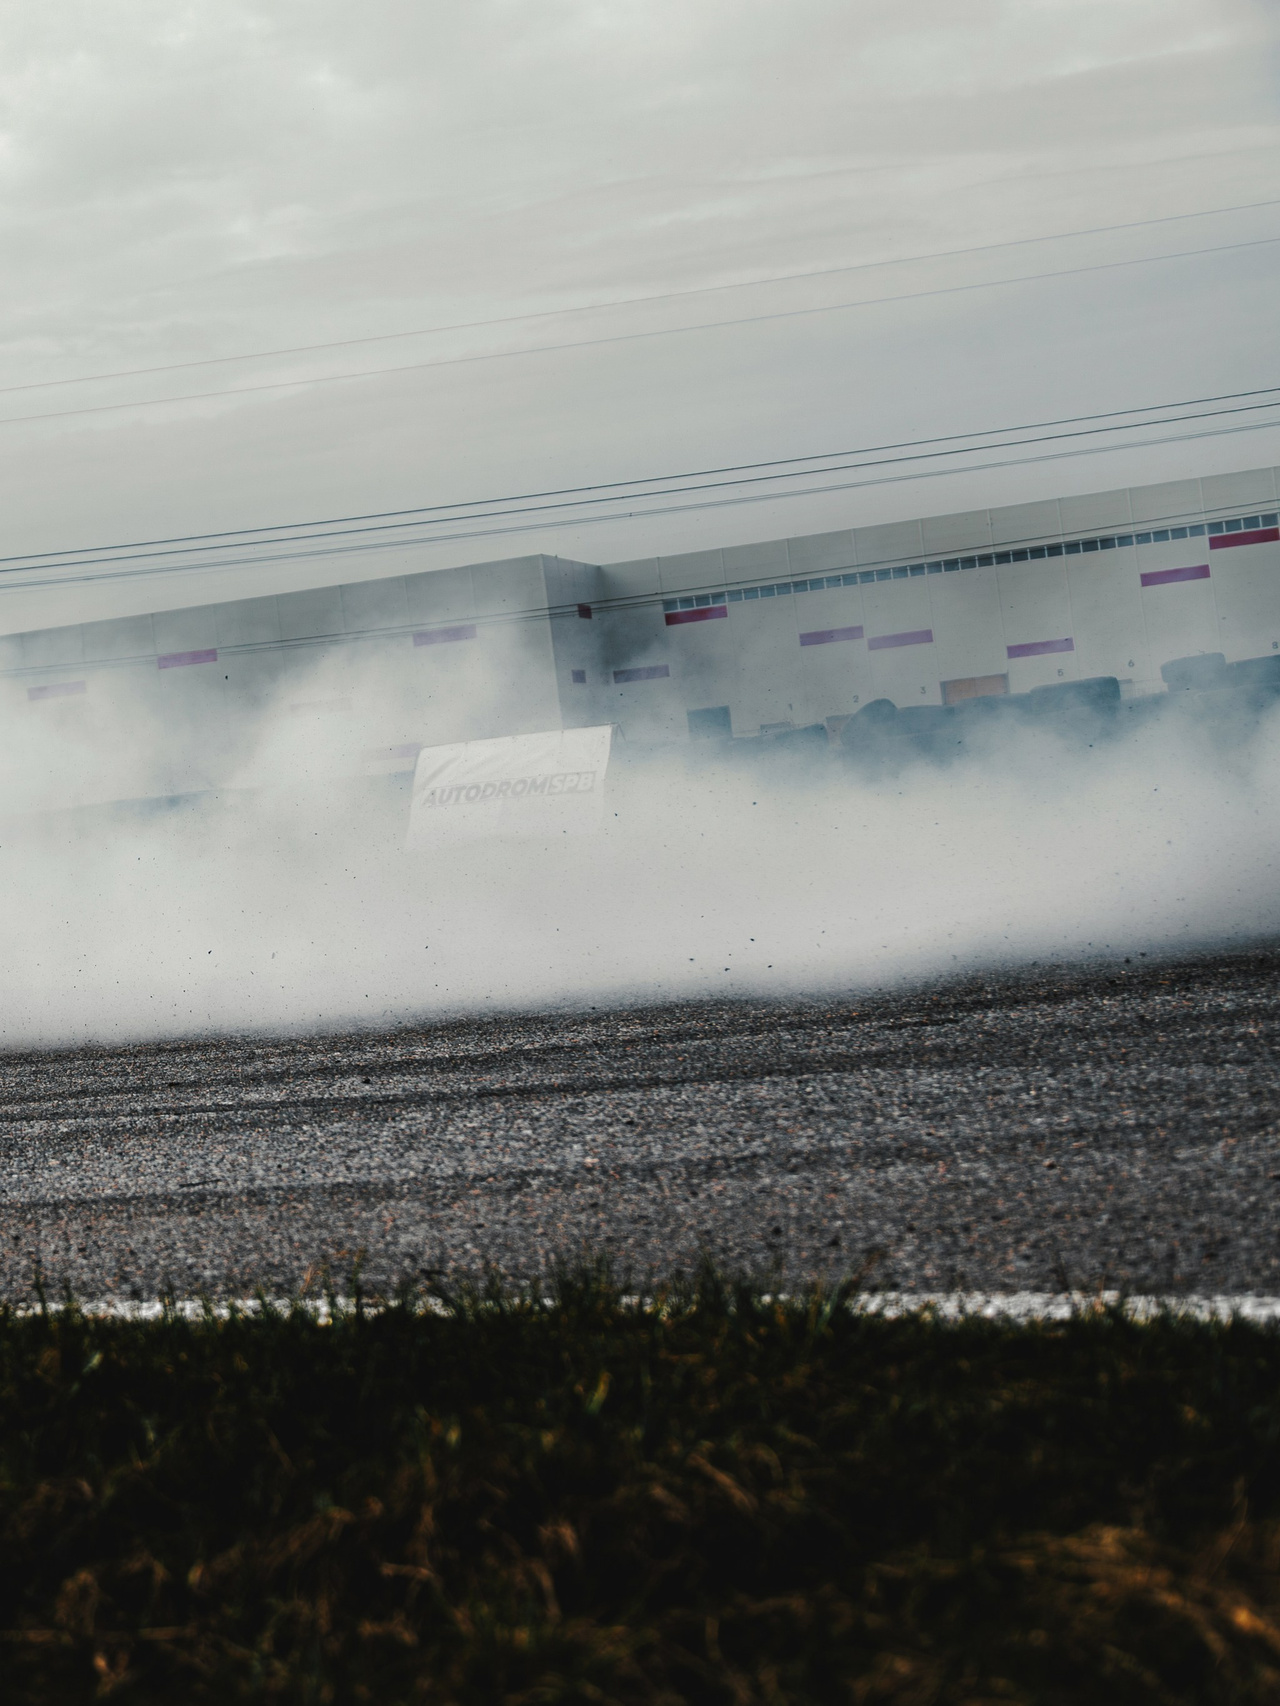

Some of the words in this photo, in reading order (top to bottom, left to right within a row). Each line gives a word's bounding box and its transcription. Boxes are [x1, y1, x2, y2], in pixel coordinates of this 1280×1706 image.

[1128, 659, 1135, 668] 6
[1057, 668, 1064, 677] 5
[852, 694, 859, 703] 2
